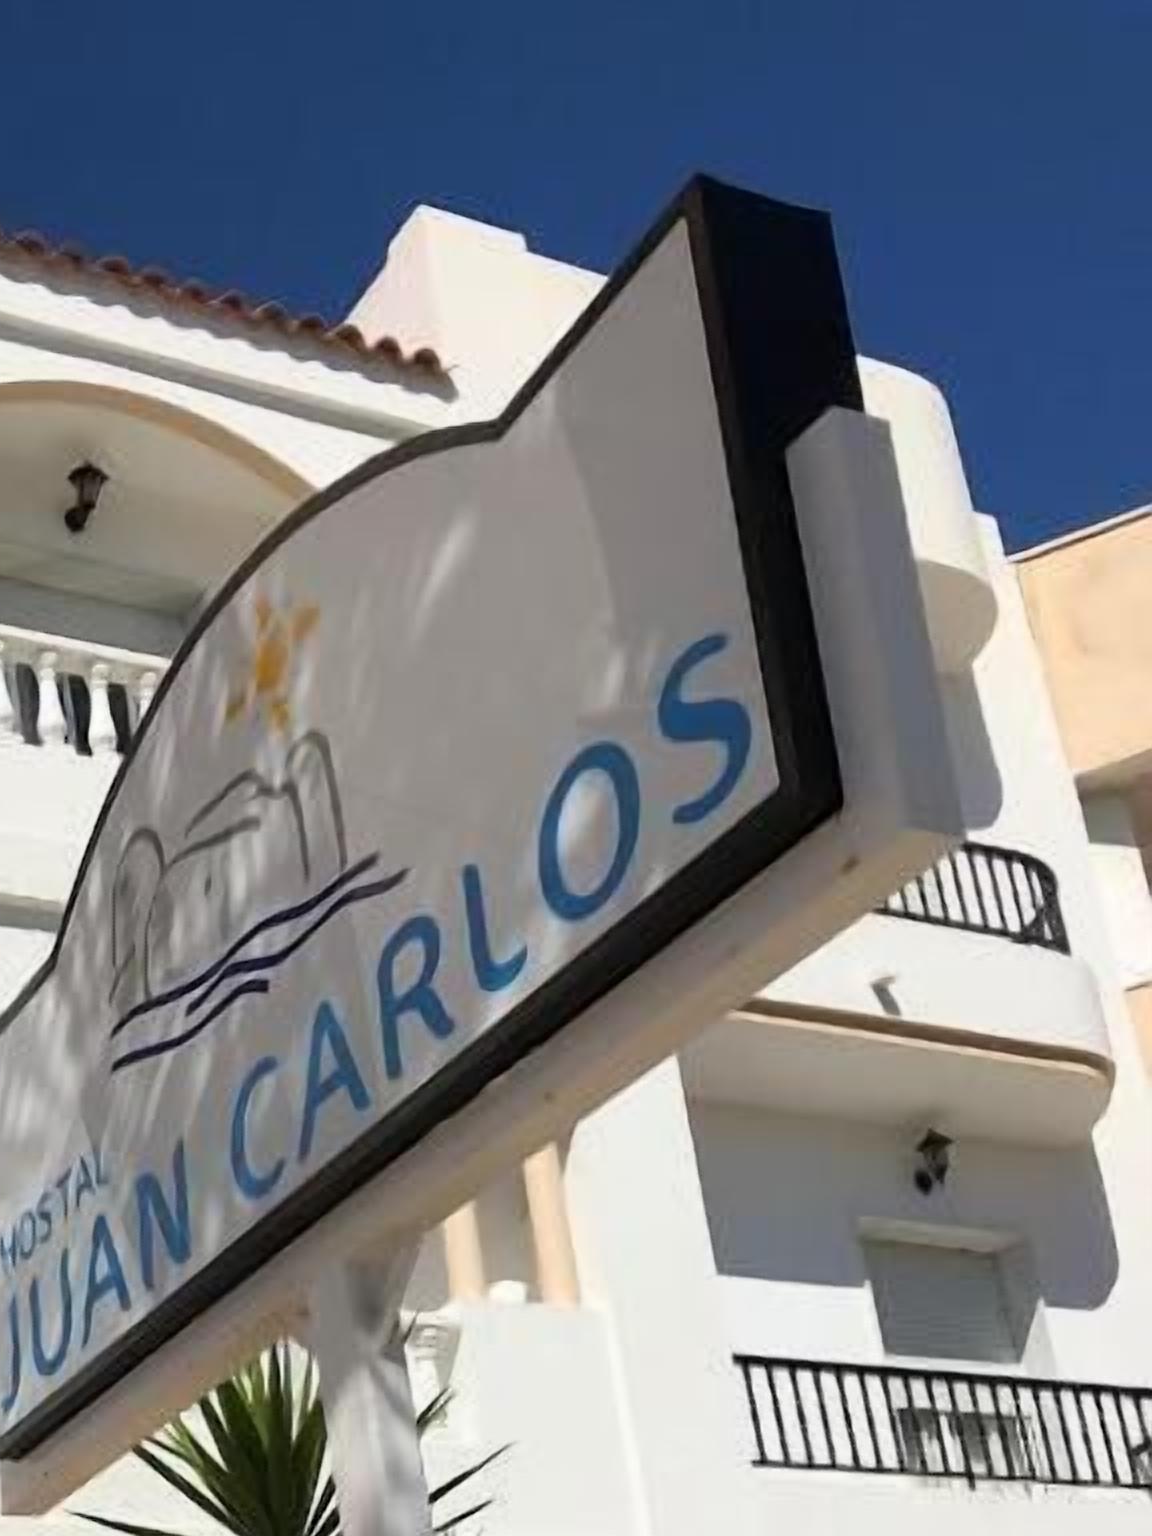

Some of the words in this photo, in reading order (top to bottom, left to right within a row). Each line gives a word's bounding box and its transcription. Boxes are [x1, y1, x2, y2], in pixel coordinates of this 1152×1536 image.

[0, 1150, 109, 1267] HOSTAL
[1, 1137, 191, 1412] JUAN
[229, 632, 753, 1201] CARLOS
